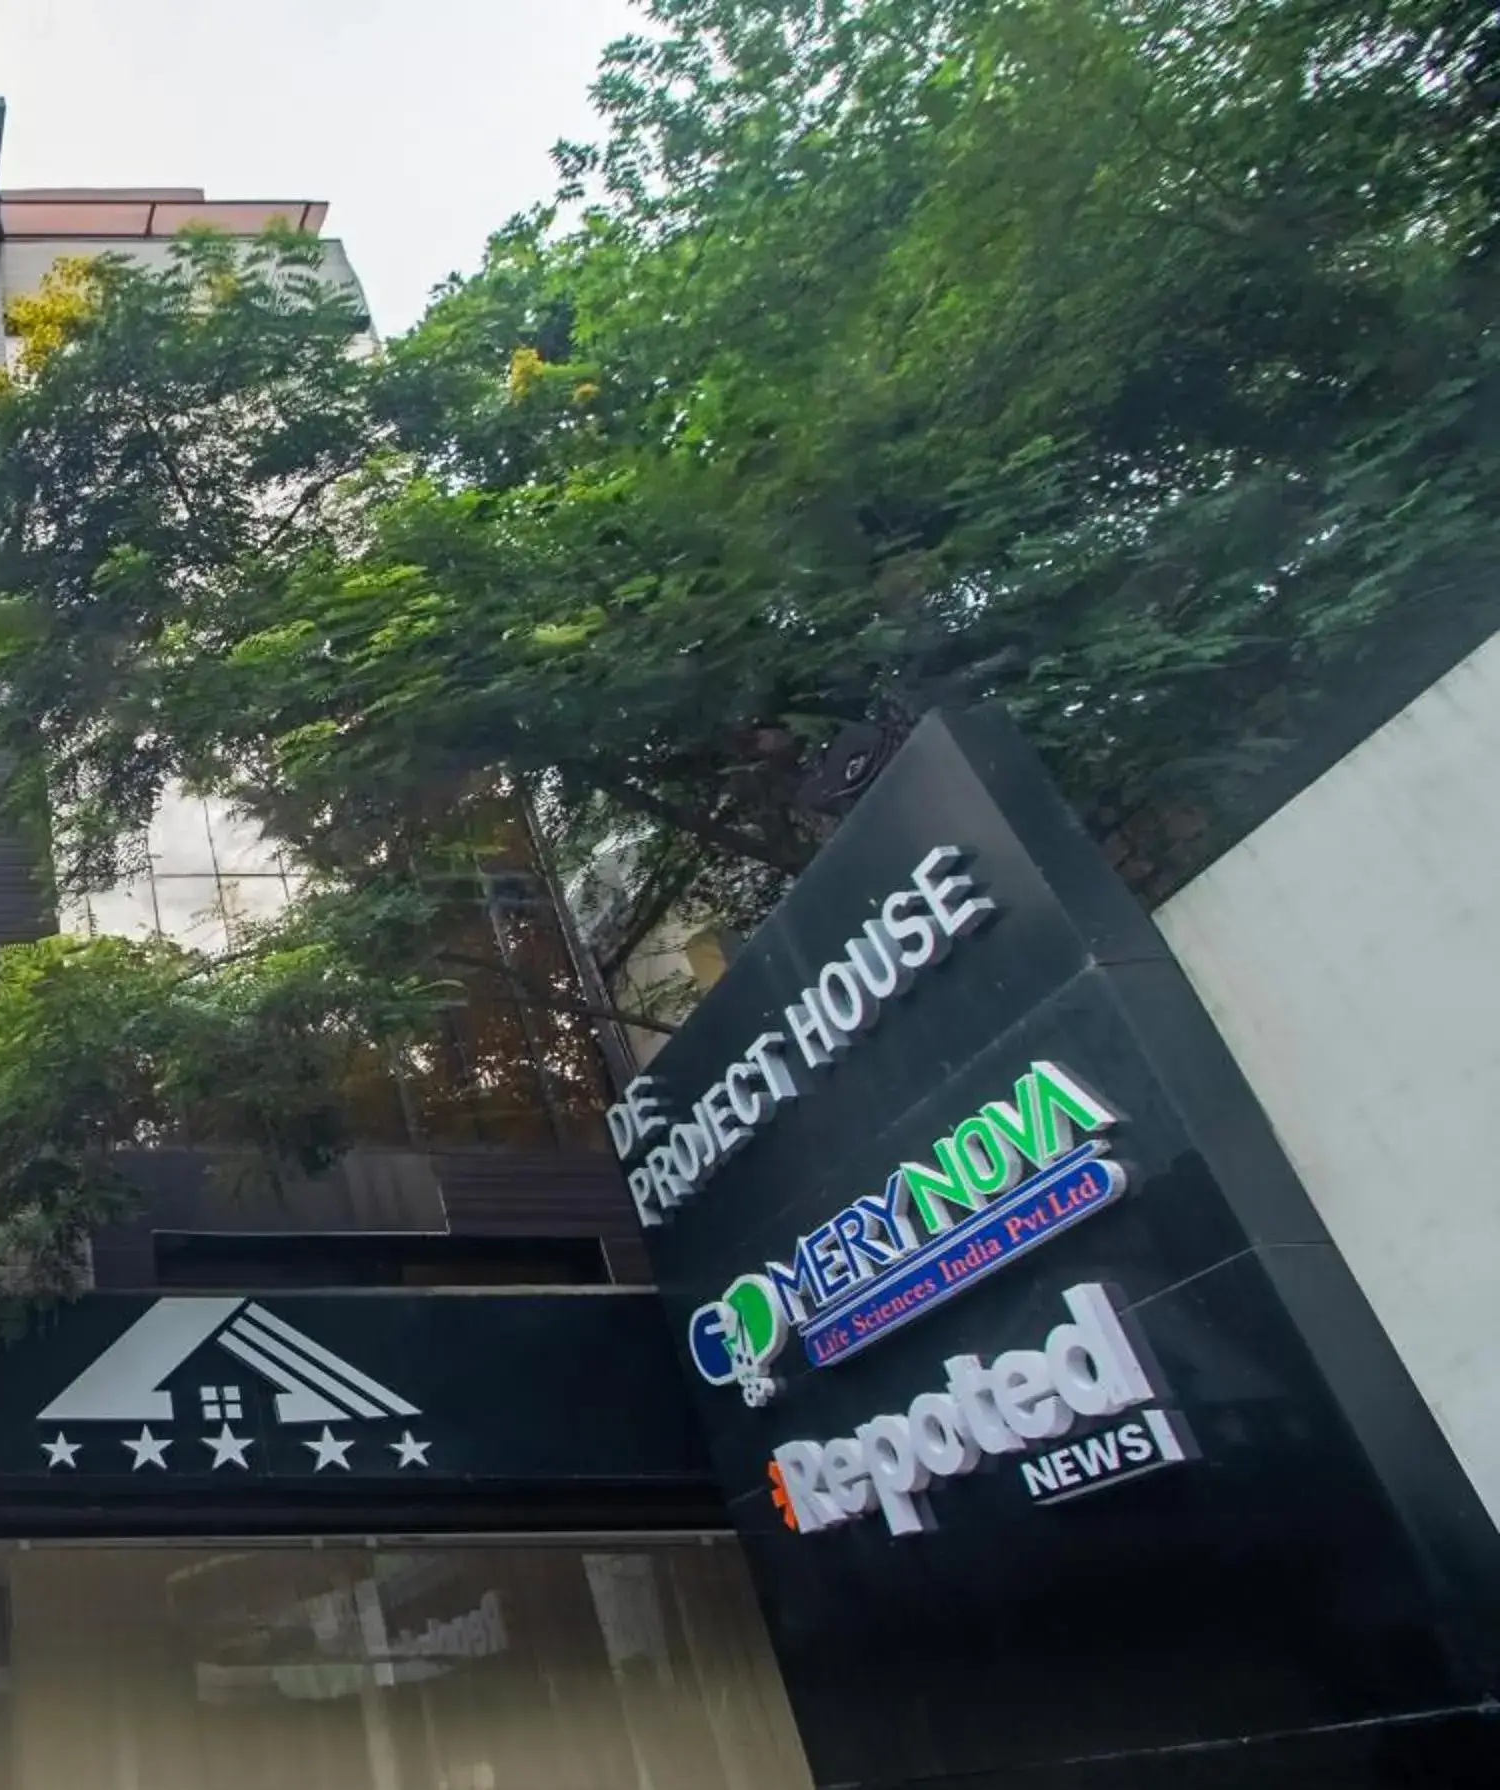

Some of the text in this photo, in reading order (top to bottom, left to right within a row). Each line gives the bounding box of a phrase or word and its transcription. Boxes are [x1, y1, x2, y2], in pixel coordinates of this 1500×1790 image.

[628, 845, 996, 1228] PROJECT HOUSE
[606, 1076, 666, 1160] DE
[813, 1171, 1100, 1361] Life Sciences India Pvt Ltd
[1020, 1423, 1153, 1497] NEWS
